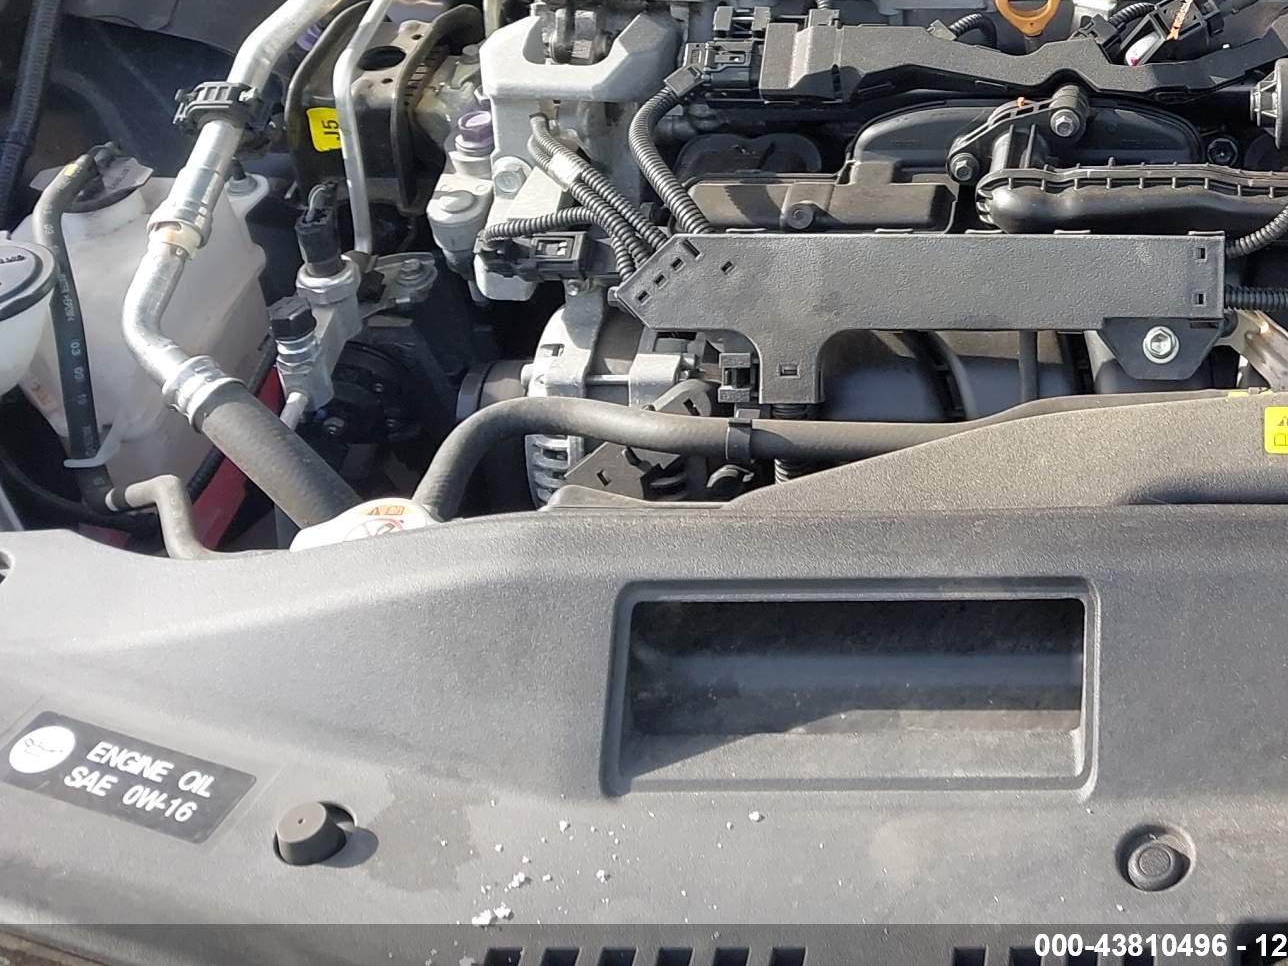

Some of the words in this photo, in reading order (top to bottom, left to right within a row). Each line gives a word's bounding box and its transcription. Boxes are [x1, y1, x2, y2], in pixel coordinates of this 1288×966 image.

[63, 766, 119, 797] SAE
[122, 784, 199, 822] 0W-16
[86, 741, 174, 783] ENGINE
[178, 770, 217, 798] OIL
